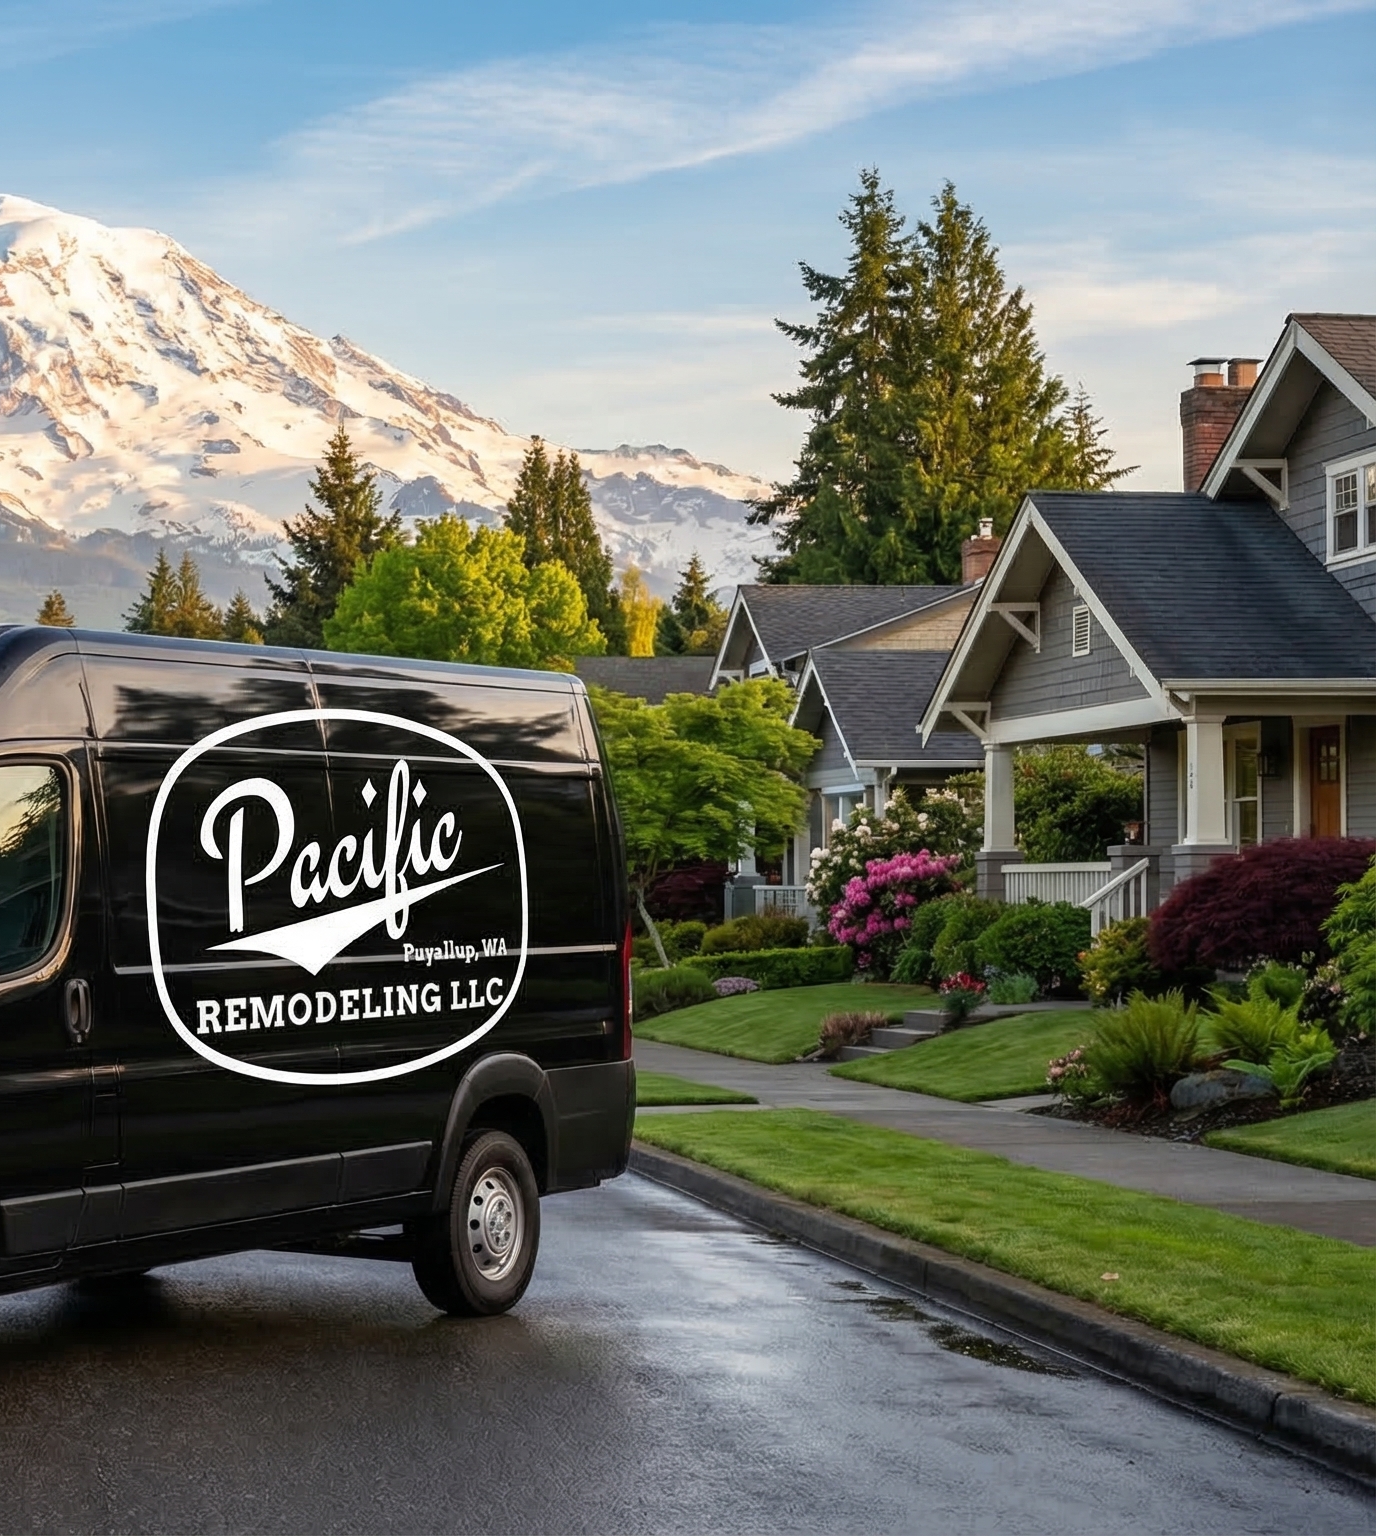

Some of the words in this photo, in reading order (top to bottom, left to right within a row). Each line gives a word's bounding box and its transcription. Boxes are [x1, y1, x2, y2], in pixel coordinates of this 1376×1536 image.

[200, 759, 463, 940] Pacific
[403, 940, 479, 967] Puyallup,
[481, 937, 508, 957] WA
[196, 982, 442, 1035] REMODELING
[450, 977, 504, 1011] LLC
